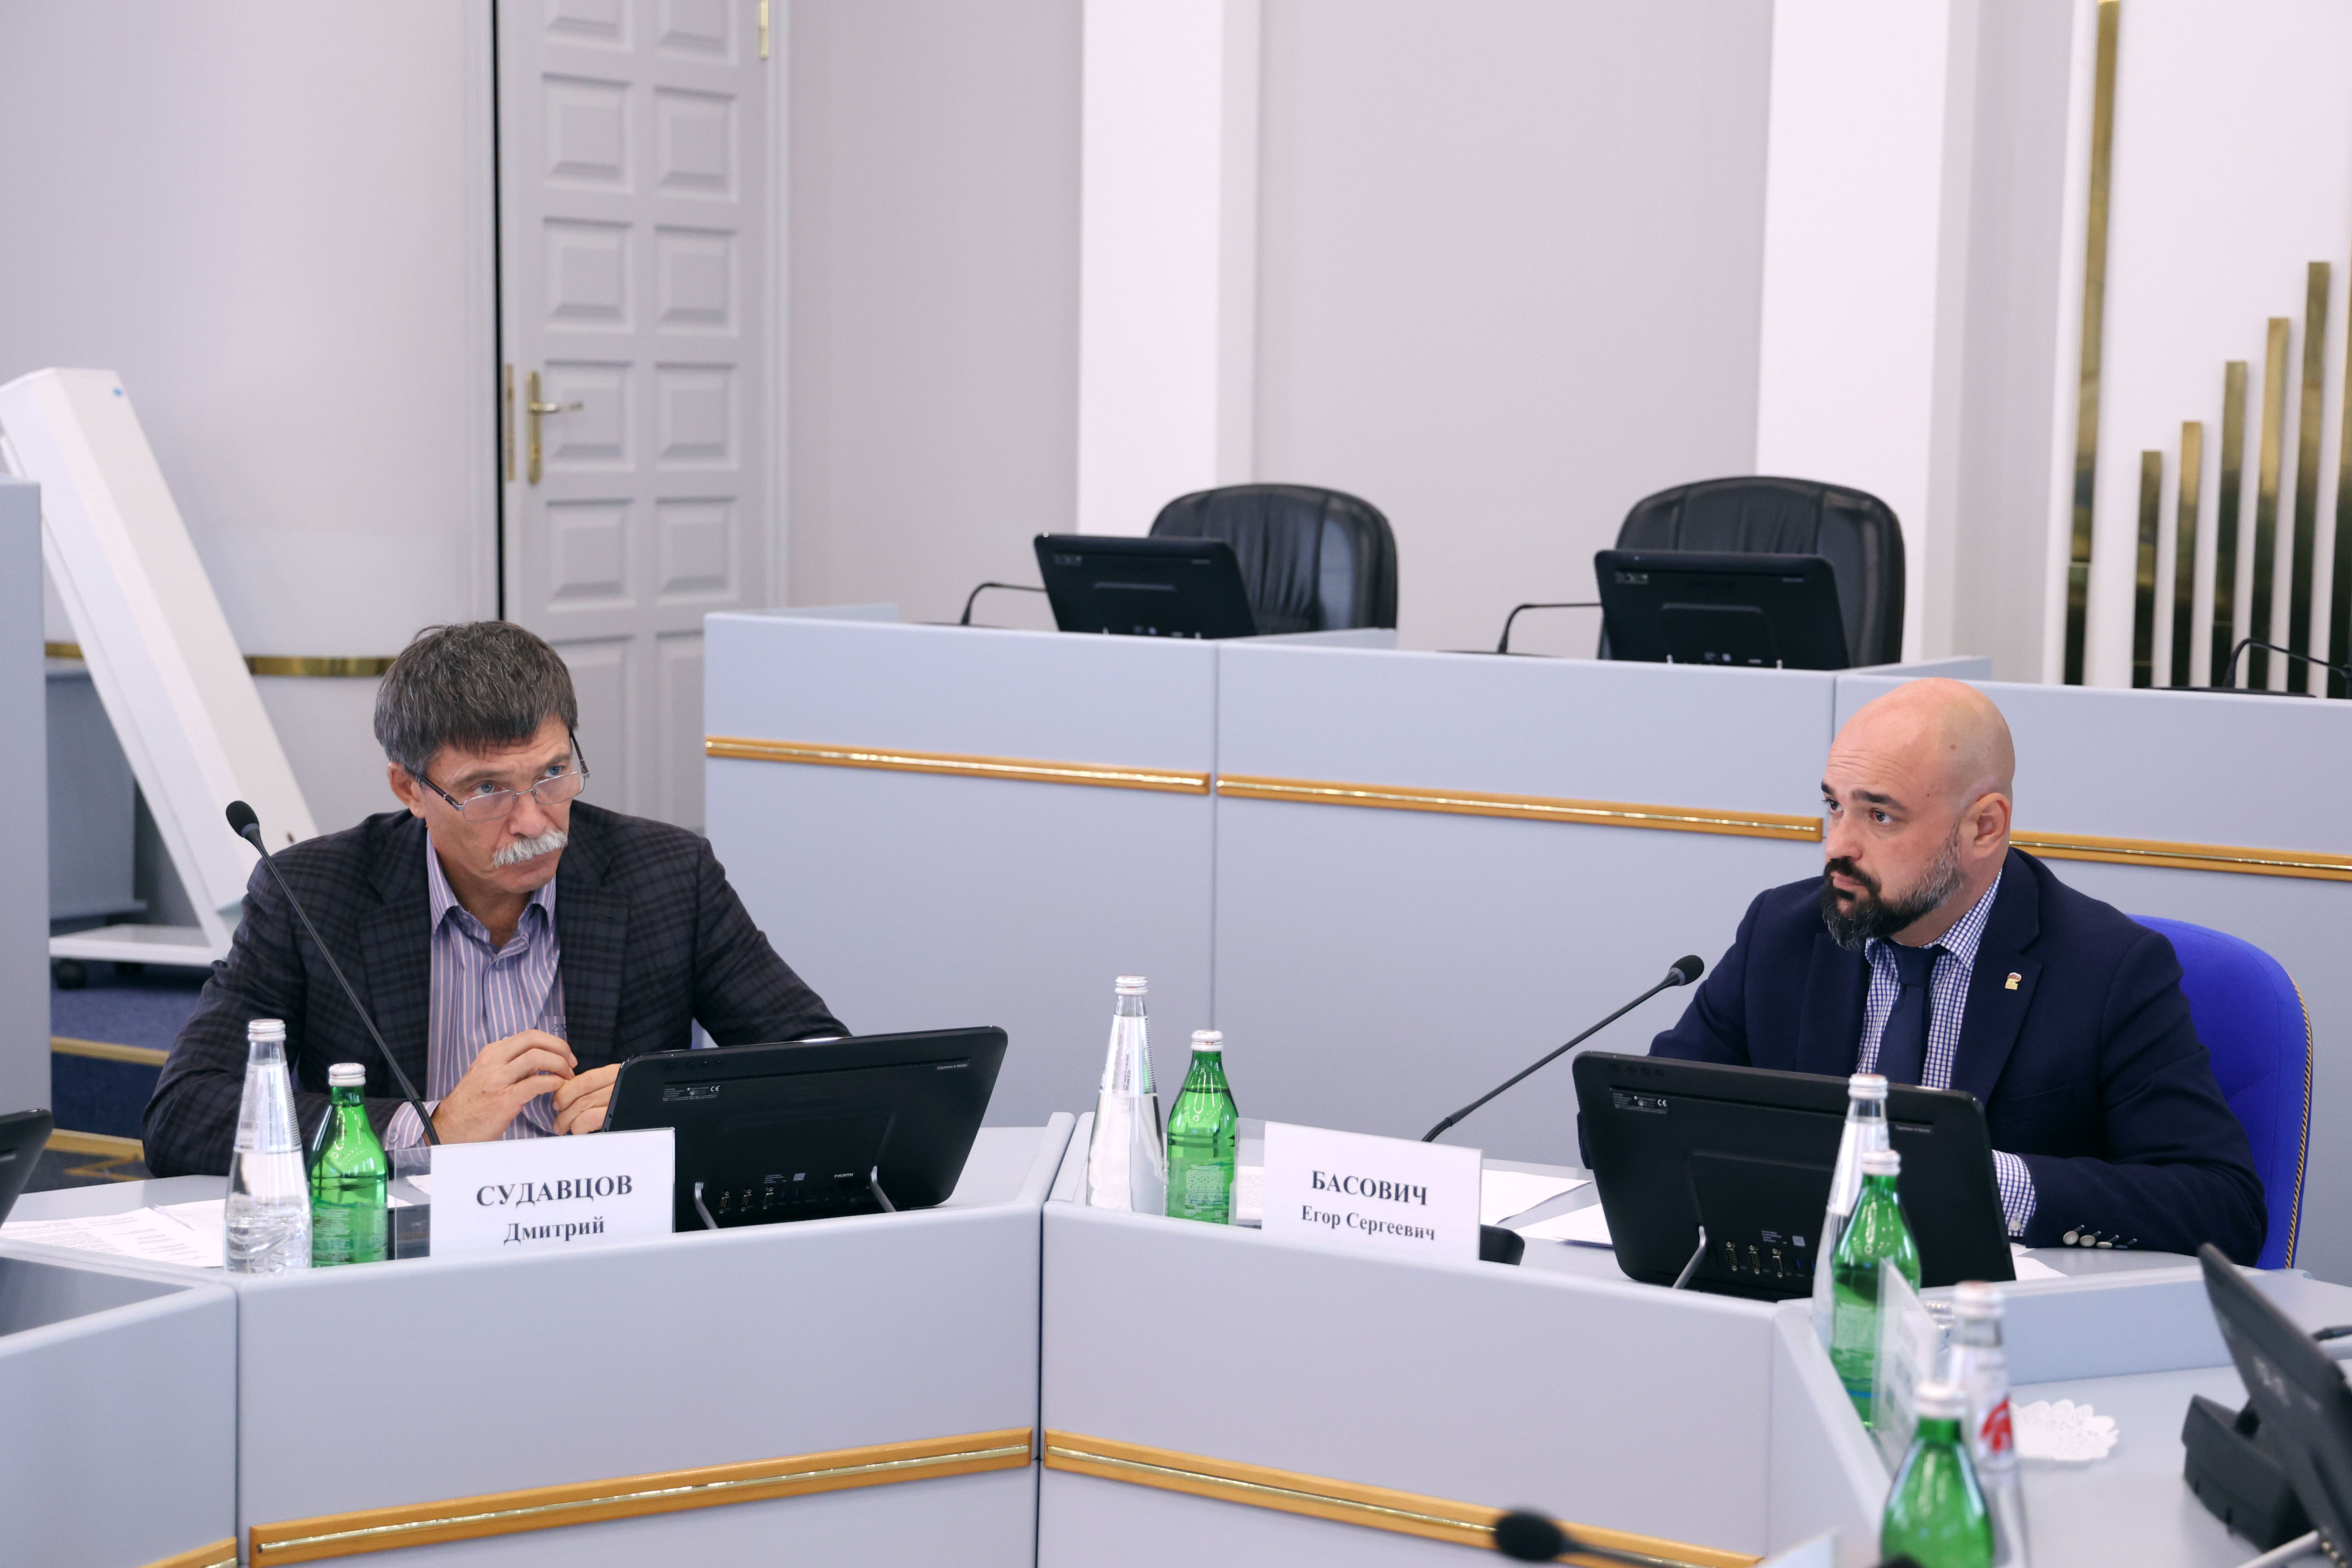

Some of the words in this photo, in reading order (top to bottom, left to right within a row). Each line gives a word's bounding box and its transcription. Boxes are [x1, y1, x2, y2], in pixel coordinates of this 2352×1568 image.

[477, 1175, 633, 1209] СУДАВЦОВ
[1311, 1170, 1428, 1206] БАСОВИЧ
[504, 1215, 605, 1246] Дмитрий
[1301, 1205, 1341, 1229] Егор
[1346, 1212, 1435, 1241] Сергеевич
